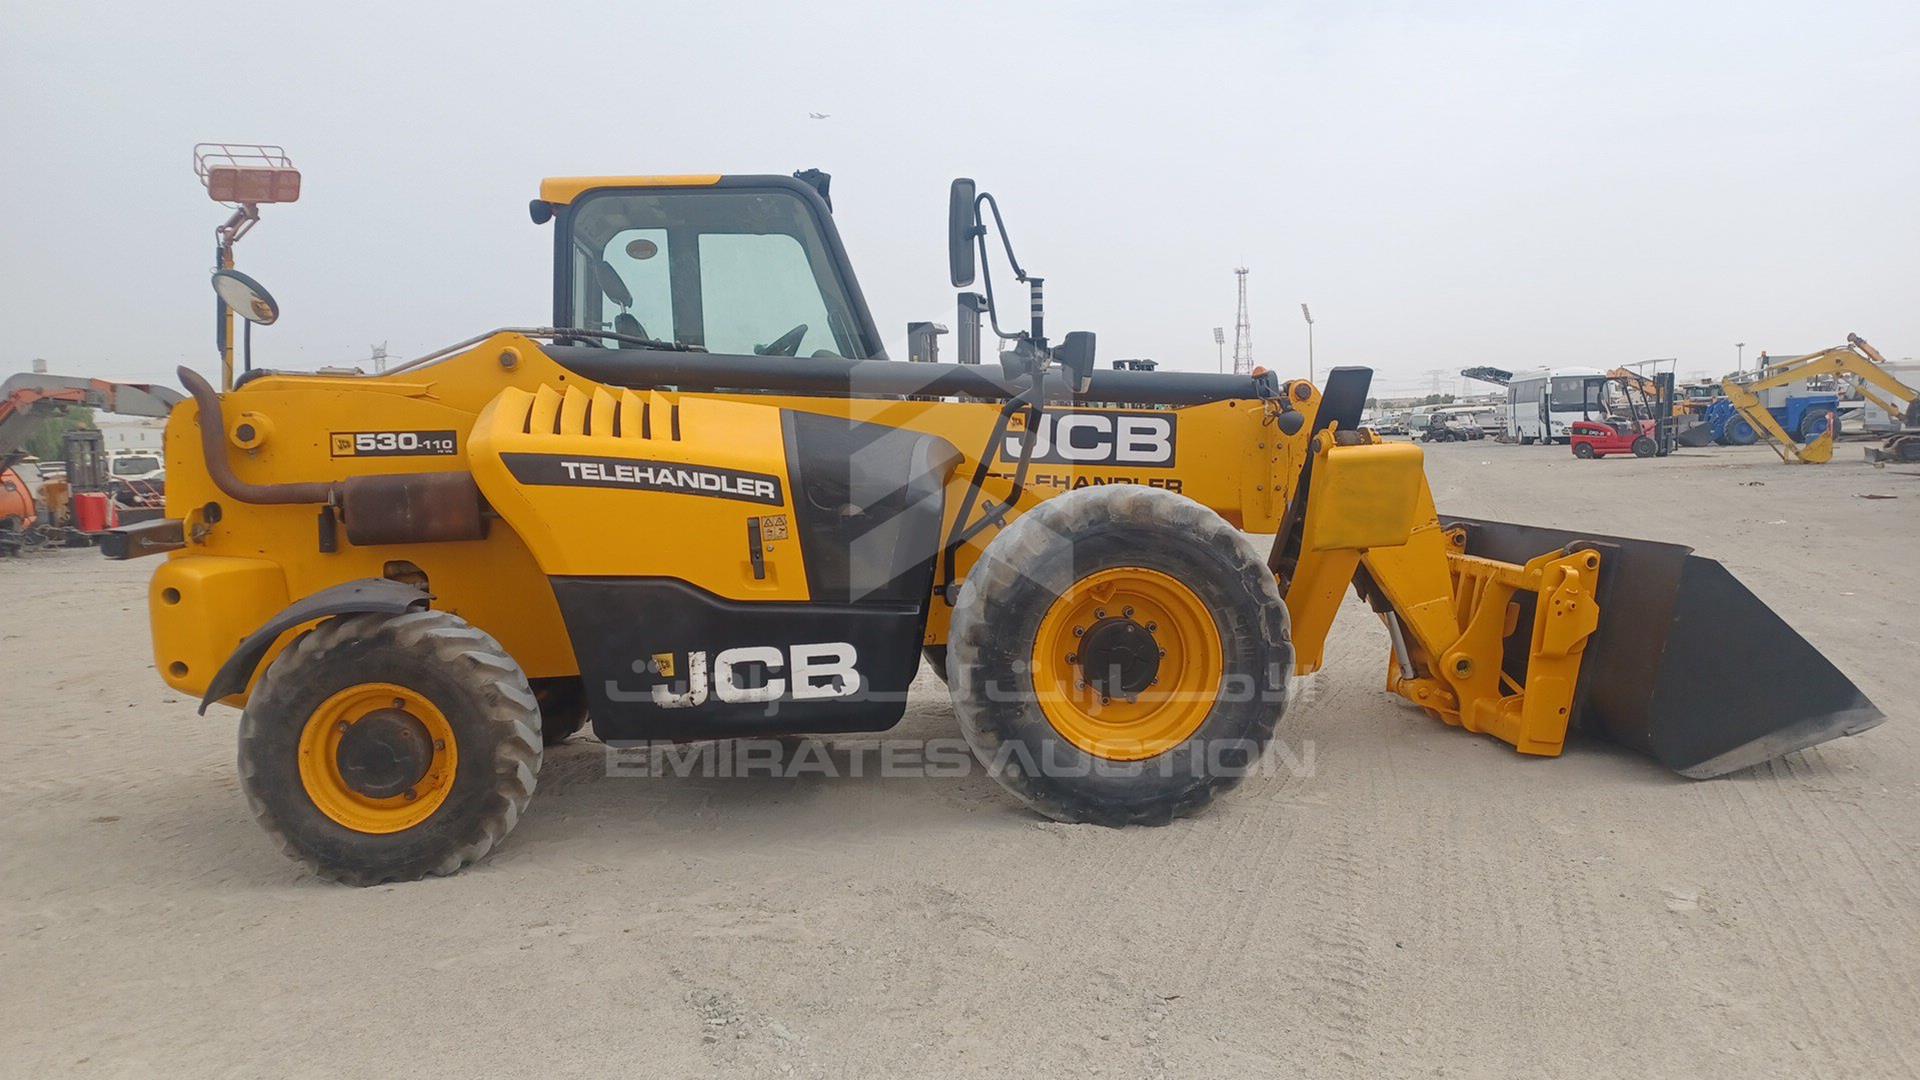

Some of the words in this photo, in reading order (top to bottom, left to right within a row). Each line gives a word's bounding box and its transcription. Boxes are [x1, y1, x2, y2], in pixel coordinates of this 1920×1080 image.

[355, 433, 453, 451] 530-110
[1006, 413, 1172, 462] JCB
[561, 461, 775, 499] TELEHANDLER
[986, 472, 1183, 495] EHANER
[652, 642, 861, 709] JCB
